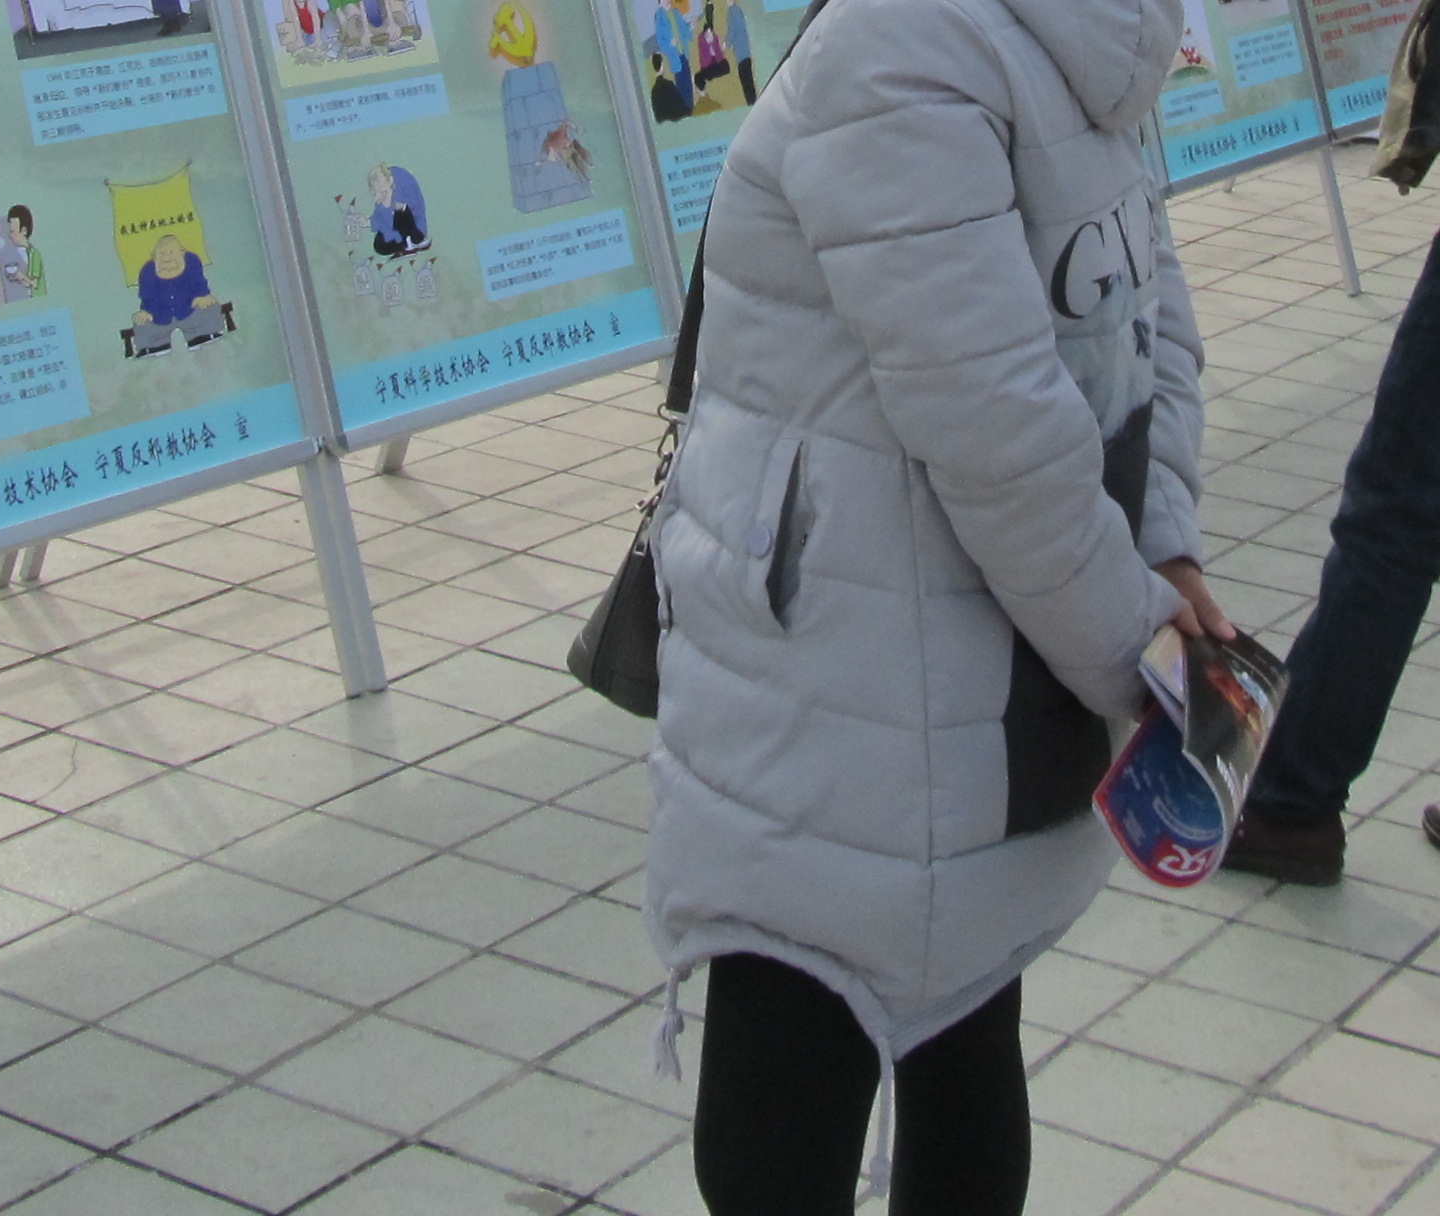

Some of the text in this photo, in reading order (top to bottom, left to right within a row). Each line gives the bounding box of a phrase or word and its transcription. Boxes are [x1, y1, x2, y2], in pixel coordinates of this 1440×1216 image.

[93, 422, 218, 481] 宁夏反邪教协会
[232, 411, 252, 442] 宣
